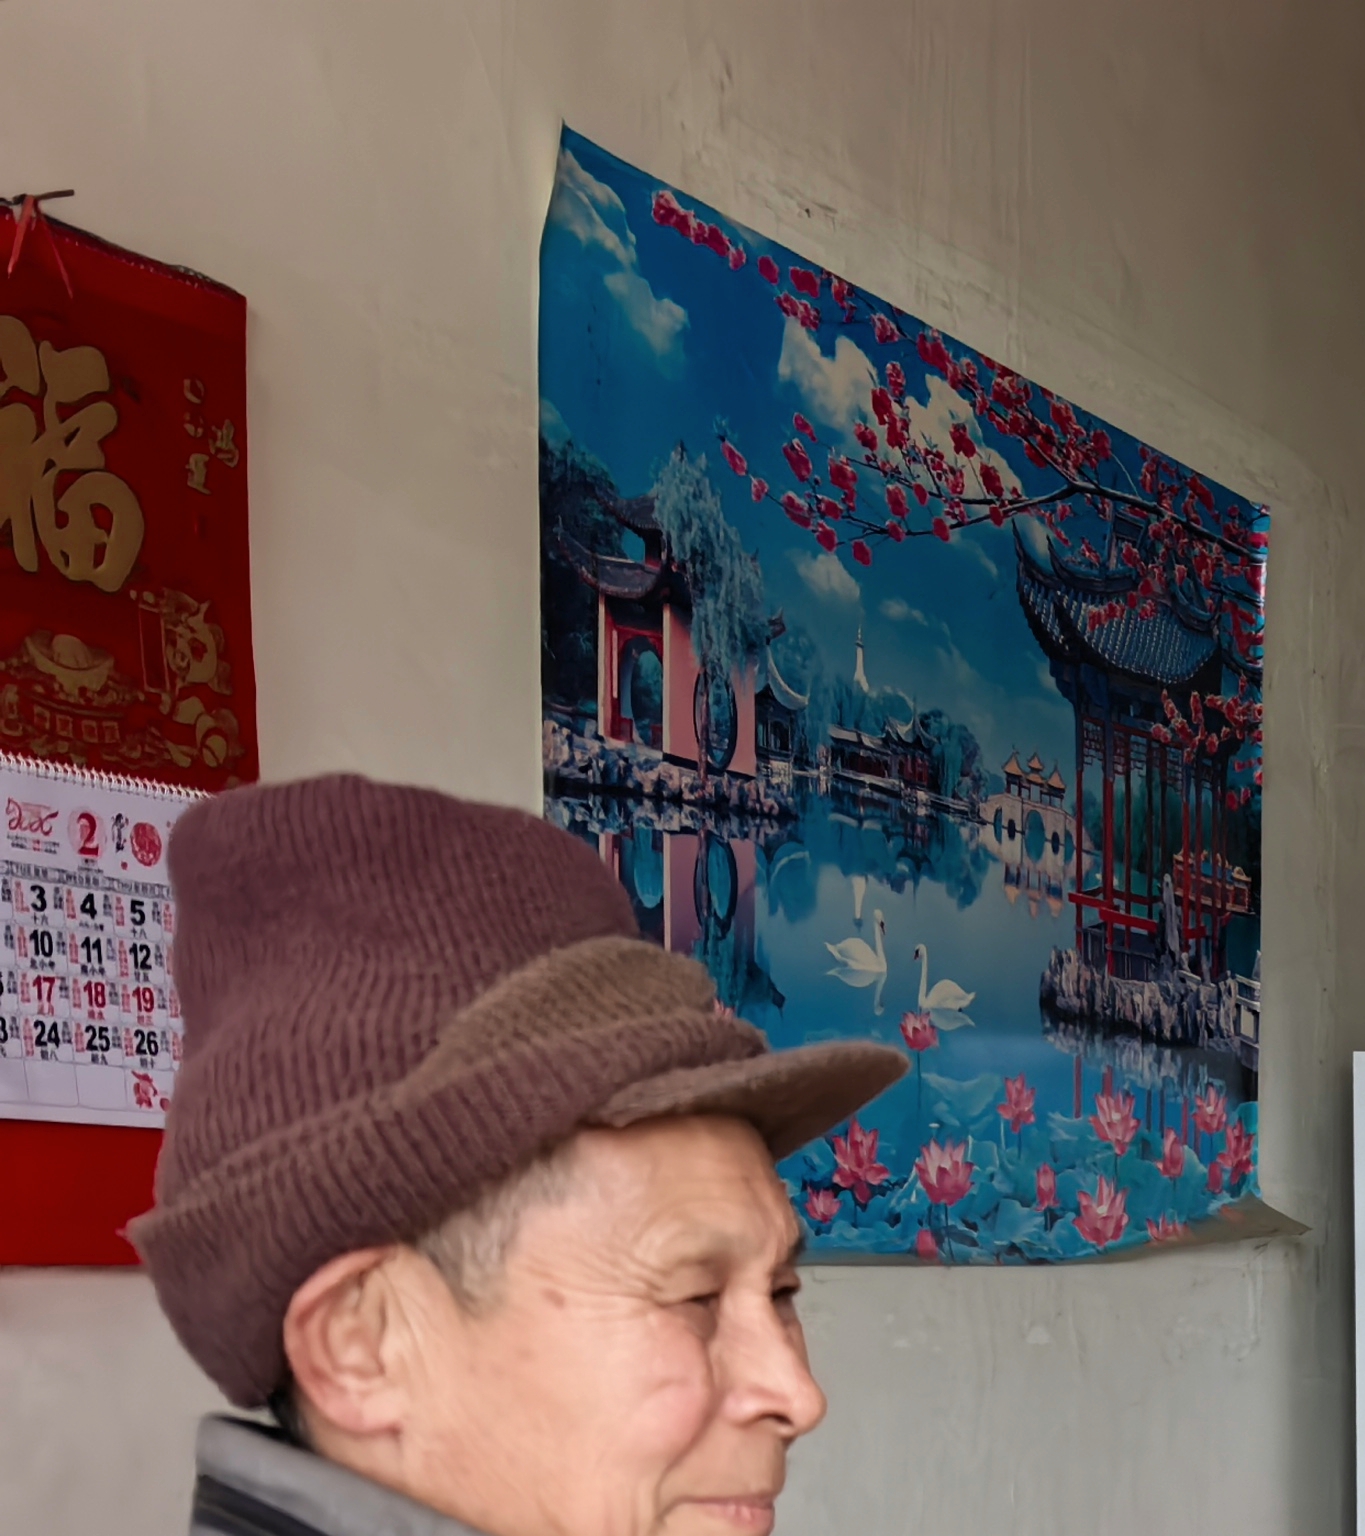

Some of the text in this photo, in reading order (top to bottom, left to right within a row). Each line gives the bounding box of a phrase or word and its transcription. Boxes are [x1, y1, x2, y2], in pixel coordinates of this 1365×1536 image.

[77, 812, 99, 856] 2
[30, 885, 47, 912] 3
[80, 893, 97, 920] 4
[130, 900, 145, 926] 5
[29, 929, 152, 970] 10 11 12
[32, 975, 154, 1013] 17 18 19
[33, 1020, 60, 1048] 24
[85, 1025, 110, 1052] 25
[133, 1029, 158, 1056] 26
